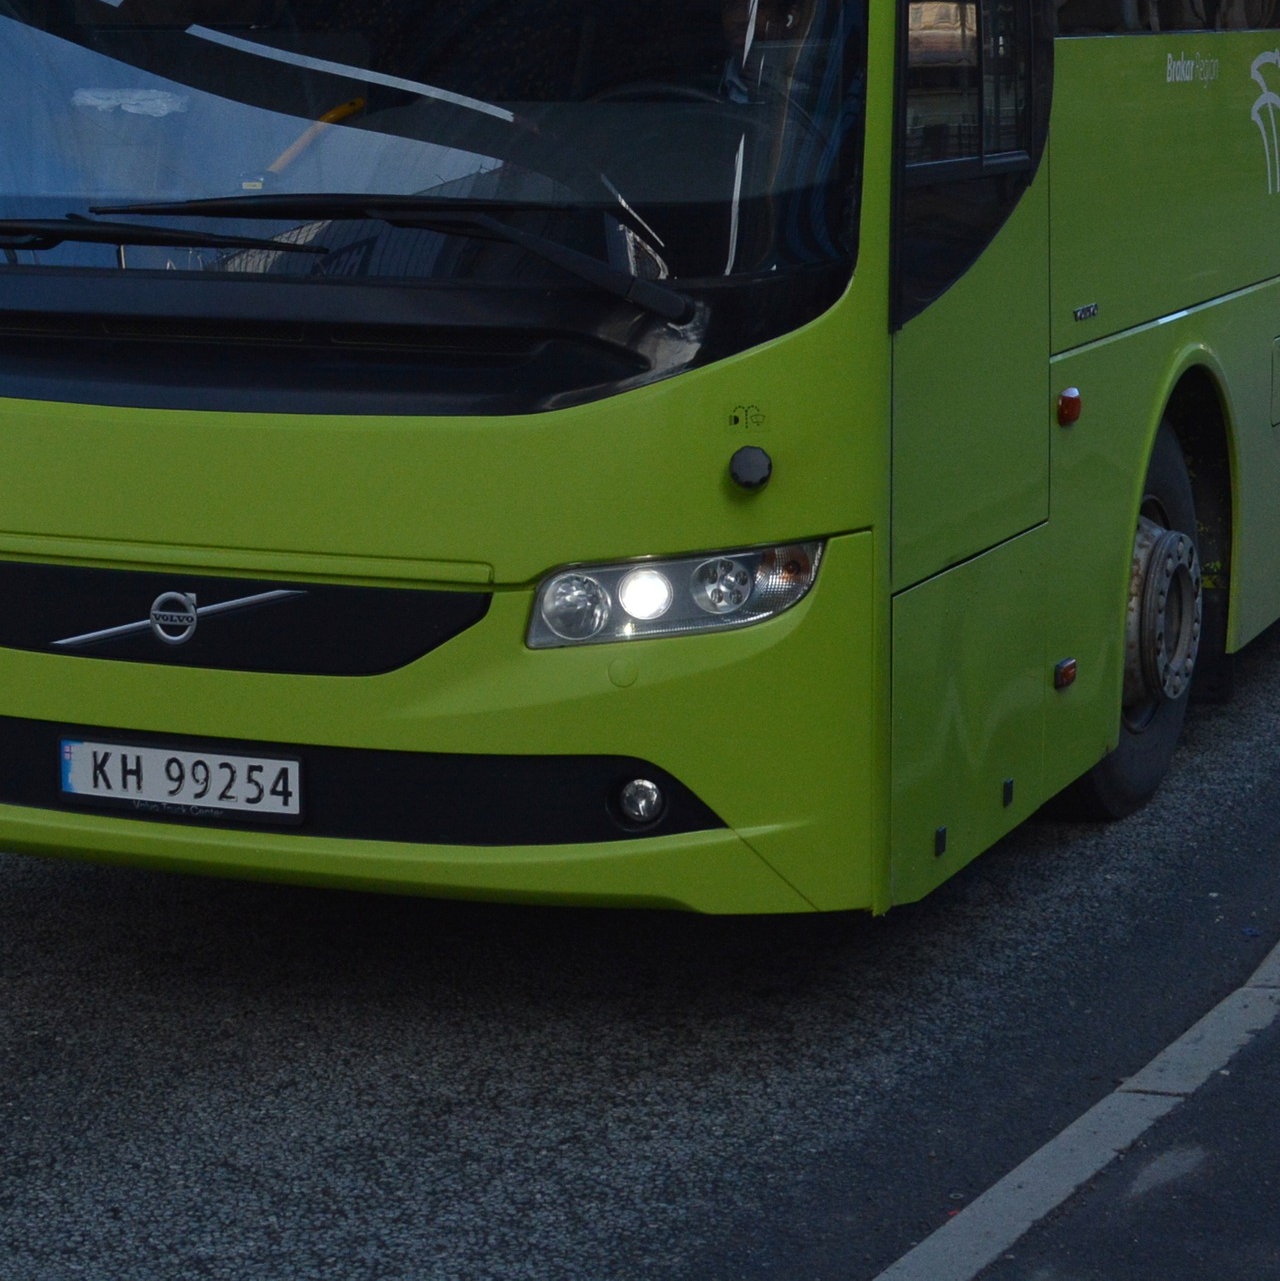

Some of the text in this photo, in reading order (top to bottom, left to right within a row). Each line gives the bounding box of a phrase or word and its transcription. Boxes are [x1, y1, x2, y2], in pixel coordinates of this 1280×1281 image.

[152, 613, 194, 624] VOLVO
[92, 750, 293, 807] KH 99254
